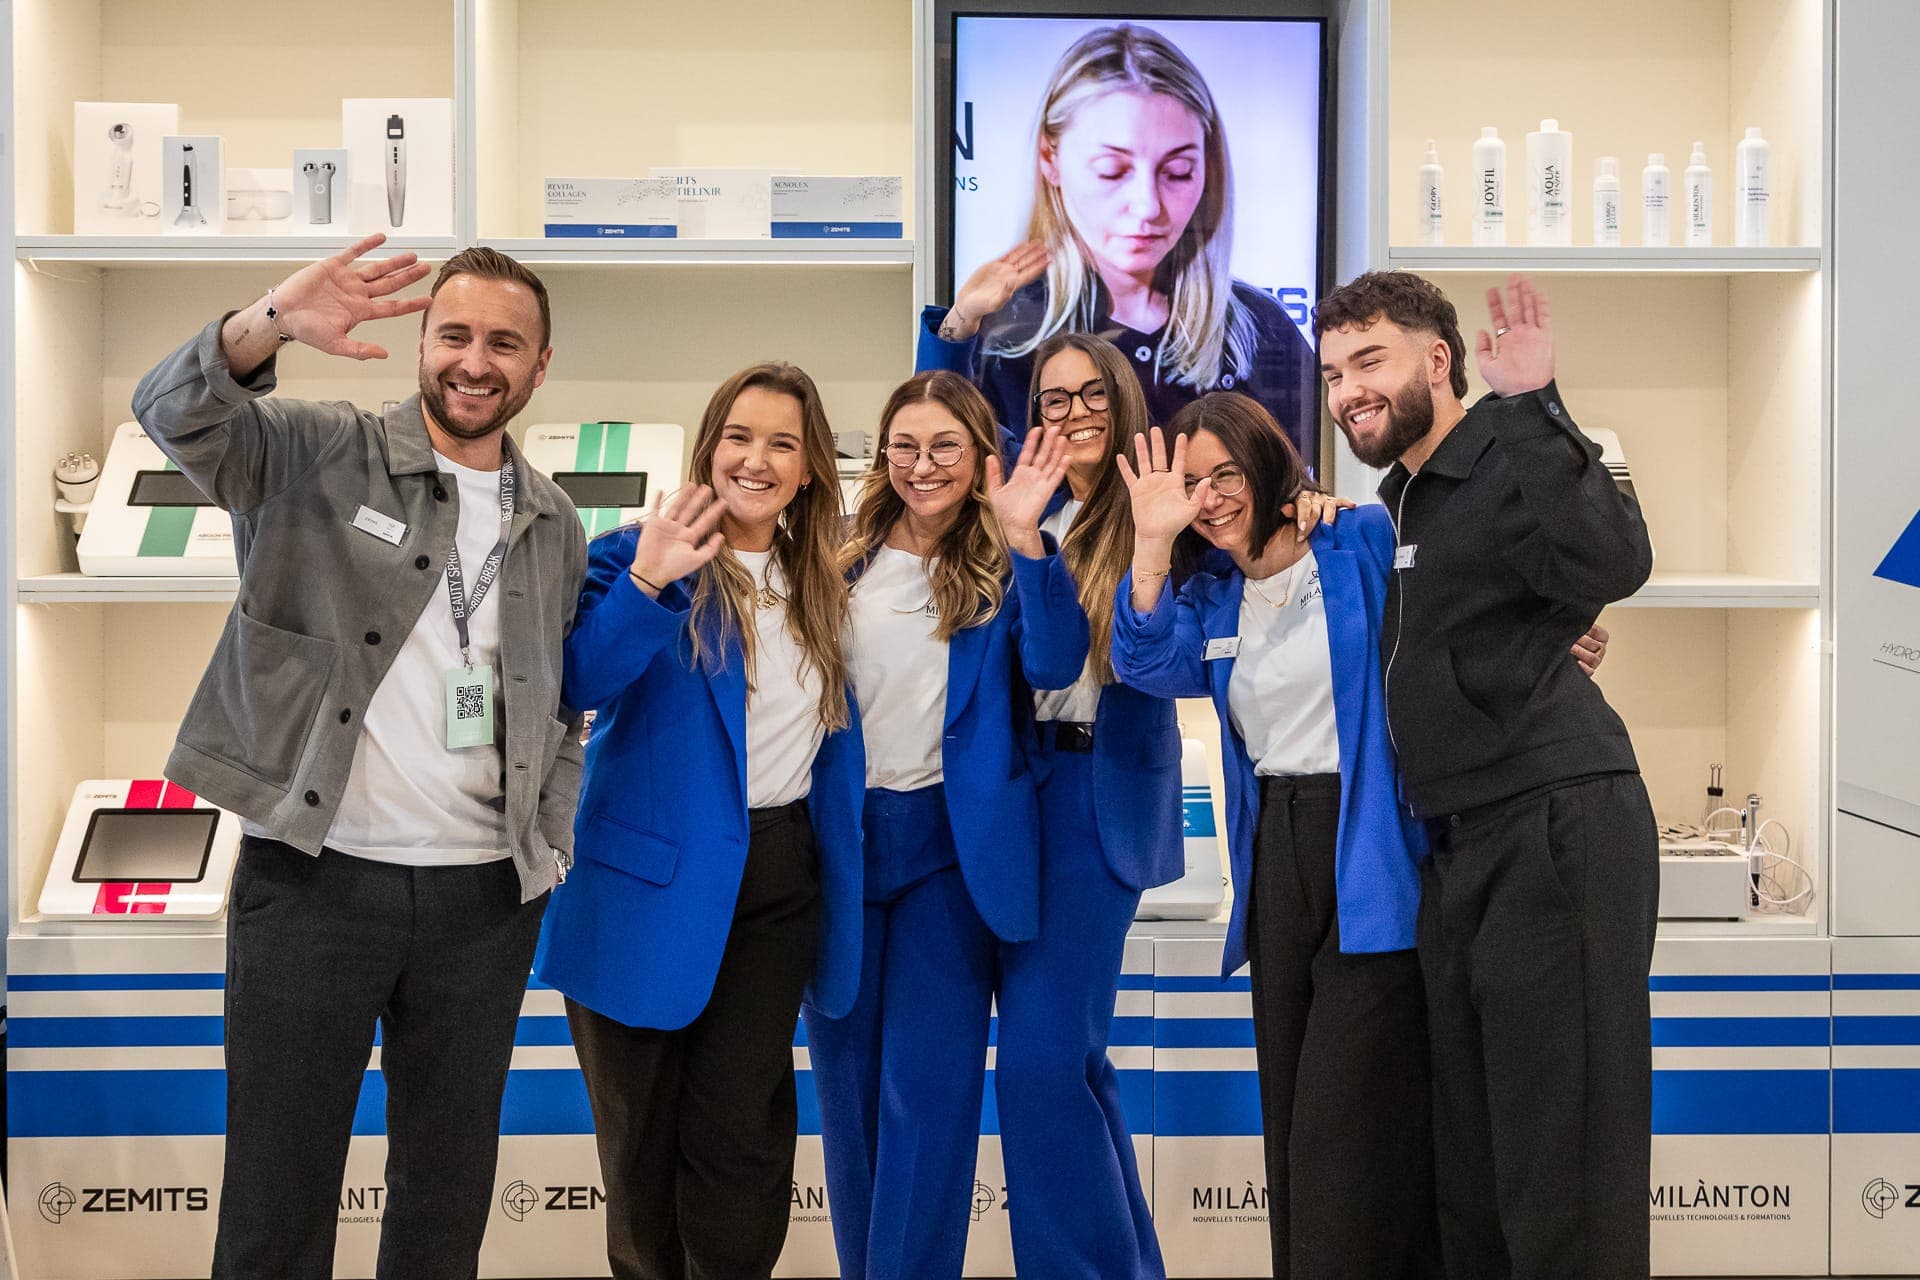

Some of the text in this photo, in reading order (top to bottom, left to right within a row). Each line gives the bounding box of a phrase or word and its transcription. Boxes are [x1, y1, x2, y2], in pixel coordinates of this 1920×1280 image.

[1544, 165, 1554, 196] AQUA
[502, 487, 514, 522] BEAUTY
[480, 555, 501, 585] BREAK
[451, 580, 465, 619] BEAUTY
[82, 1187, 208, 1212] ZEMITS
[339, 1187, 384, 1210] NT
[1648, 1178, 1790, 1208] MILÀNTON
[1904, 1184, 1920, 1208] Z
[1747, 1213, 1791, 1221] FORMATIONS
